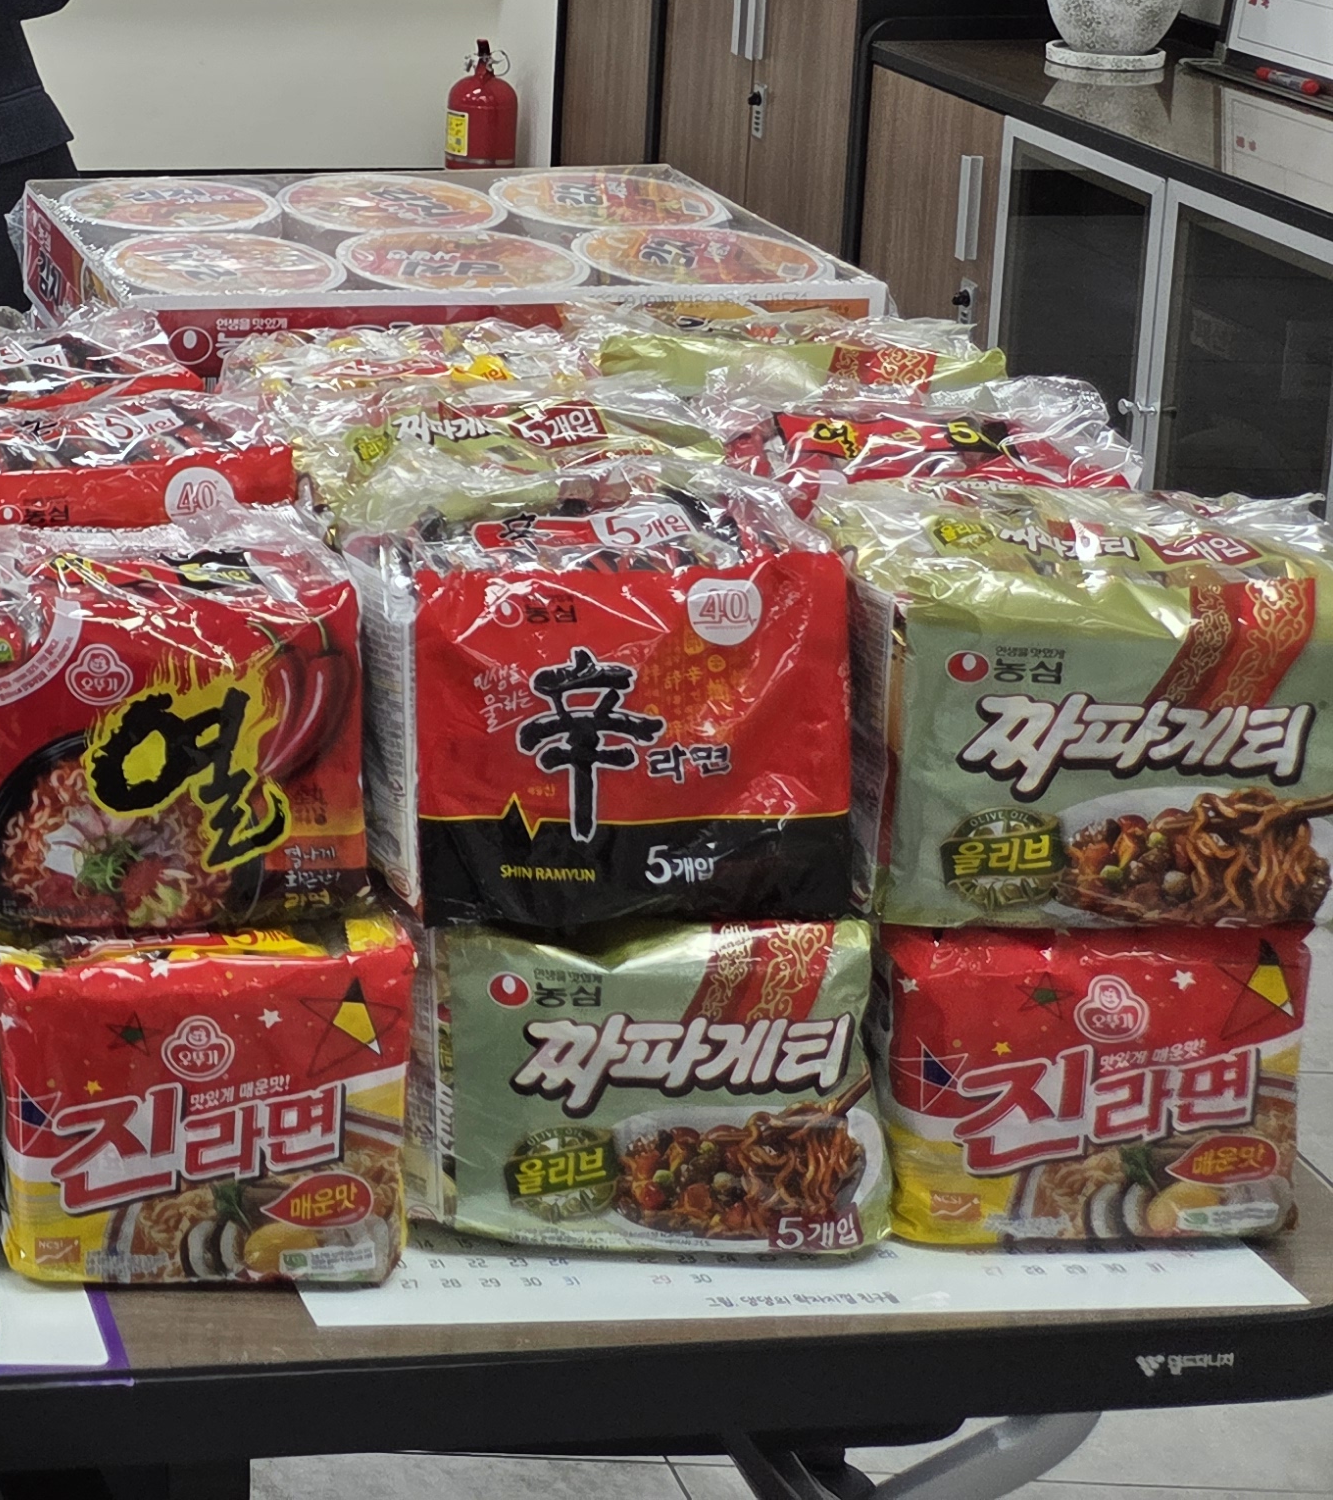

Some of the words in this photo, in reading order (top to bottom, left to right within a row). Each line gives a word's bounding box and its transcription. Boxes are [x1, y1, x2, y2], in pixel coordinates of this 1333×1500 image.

[215, 317, 251, 330] 인생을
[252, 315, 289, 329] 맛있게
[519, 409, 597, 447] 5개입
[177, 480, 219, 514] 40
[604, 513, 693, 545] 5개입
[699, 588, 749, 623] 40
[80, 676, 120, 693] 오뚜기
[993, 656, 1063, 685] 농심
[516, 646, 667, 843] 辛
[956, 691, 1314, 803] 짜파게티
[90, 686, 289, 870] 열
[646, 744, 732, 783] 라면
[969, 810, 1006, 827] OLIVE
[1010, 809, 1031, 824] OIL
[645, 843, 715, 885] 5개입
[950, 835, 1052, 875] 올리브
[500, 863, 533, 880] SHIN
[534, 866, 596, 883] RAMYUN
[532, 984, 603, 1009] 농심
[1090, 1012, 1134, 1030] 오뚜기
[178, 1048, 221, 1068] 오뚜기
[509, 1011, 856, 1119] 짜파게티
[1151, 1038, 1207, 1064] 매운맛!
[189, 1089, 235, 1113] 맛있게
[238, 1074, 291, 1099] 매운맛!
[953, 1044, 1261, 1177] 진라면
[50, 1081, 347, 1218] 진라면
[1191, 1137, 1268, 1176] 매운맛
[514, 1149, 608, 1197] 올리브
[289, 1183, 359, 1221] 매운맛
[932, 1192, 963, 1205] NCSI
[775, 1215, 860, 1250] 5개입
[690, 1272, 713, 1285] 30
